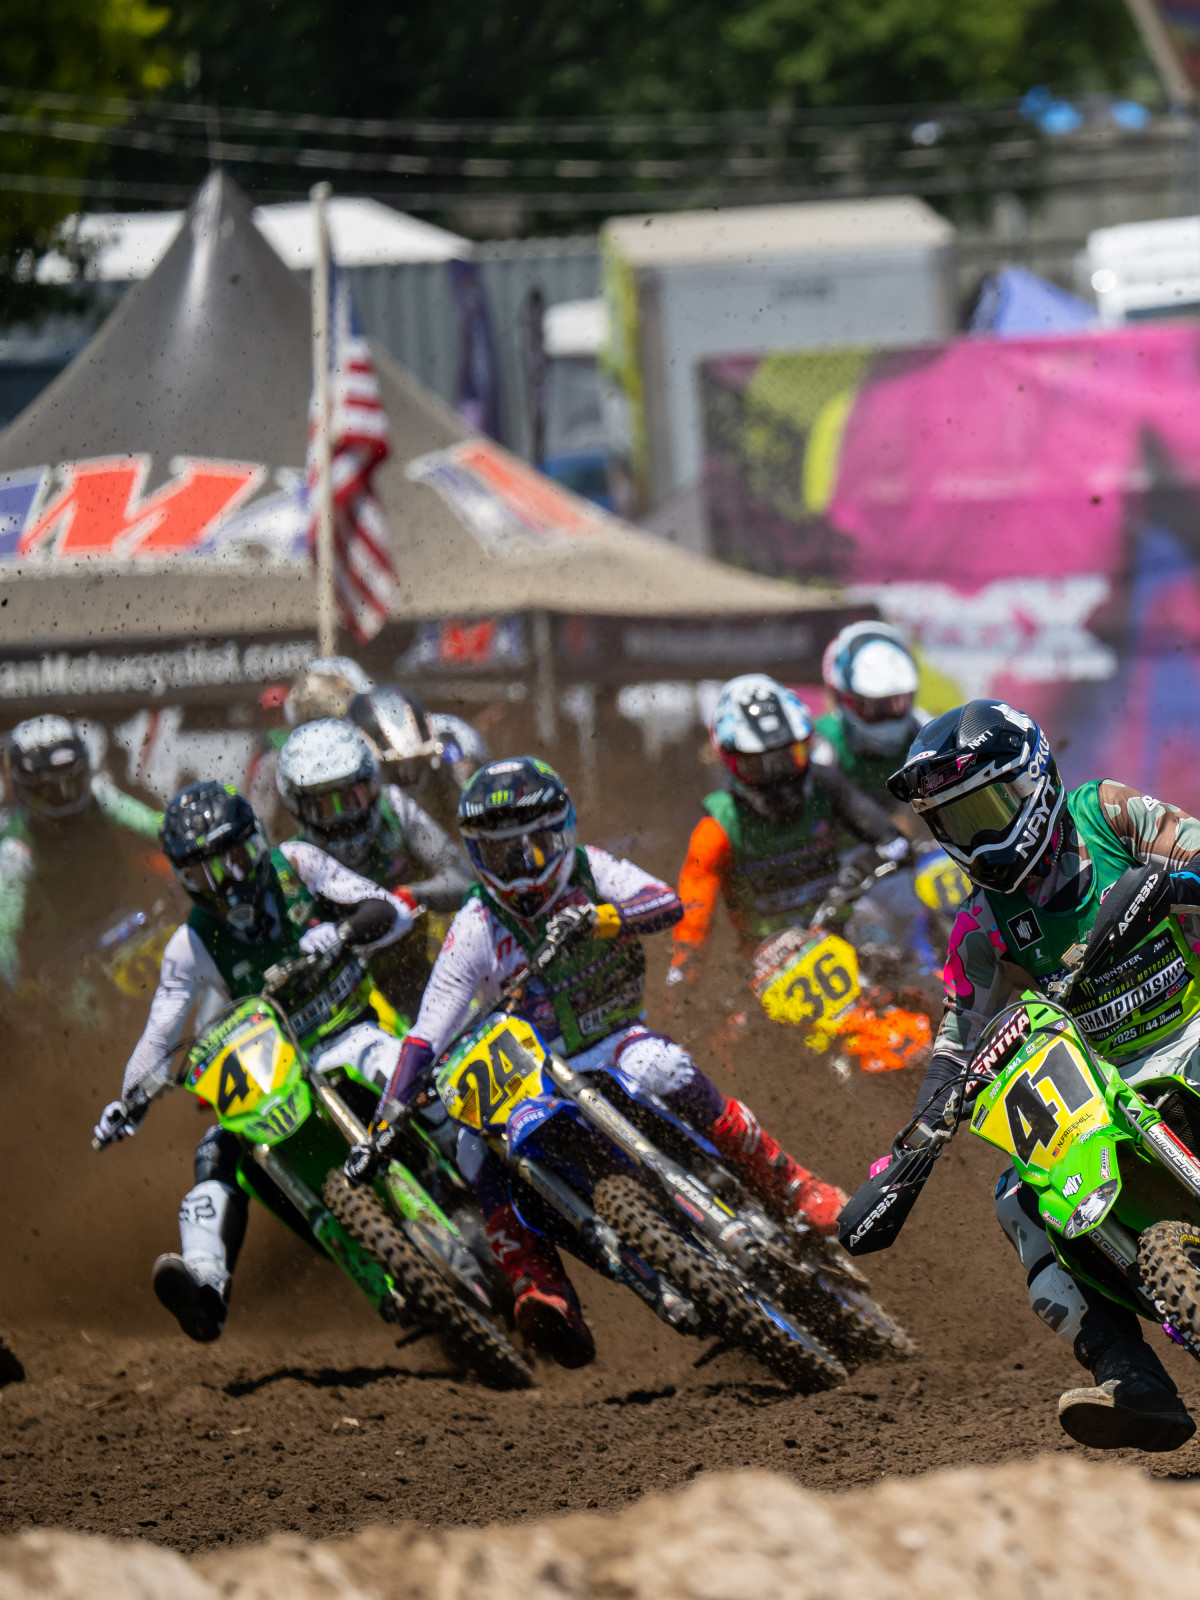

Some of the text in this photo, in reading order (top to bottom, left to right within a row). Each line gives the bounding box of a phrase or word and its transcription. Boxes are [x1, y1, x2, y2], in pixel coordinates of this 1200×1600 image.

[967, 730, 994, 750] NAYT
[1015, 775, 1056, 859] NAYT
[1118, 873, 1159, 936] ACERBIS
[783, 952, 854, 1026] 36
[1080, 959, 1184, 1031] CHAMPIONSHIP
[1094, 954, 1143, 984] MONSTER
[1098, 979, 1135, 1003] NATIONAL
[1137, 949, 1177, 983] MOTOCROSS
[964, 1012, 1031, 1095] RENTHA
[1112, 1027, 1137, 1047] 2025
[1145, 1018, 1159, 1031] 44
[217, 1026, 278, 1115] 47
[457, 1028, 537, 1125] 24
[989, 1080, 1003, 1100] 2025
[513, 1110, 545, 1142] YAMAHA
[1004, 1038, 1097, 1168] 41
[1057, 1111, 1094, 1149] N.FREEHILL
[1062, 1173, 1083, 1199] NAYT
[849, 1192, 898, 1248] ACERBIS
